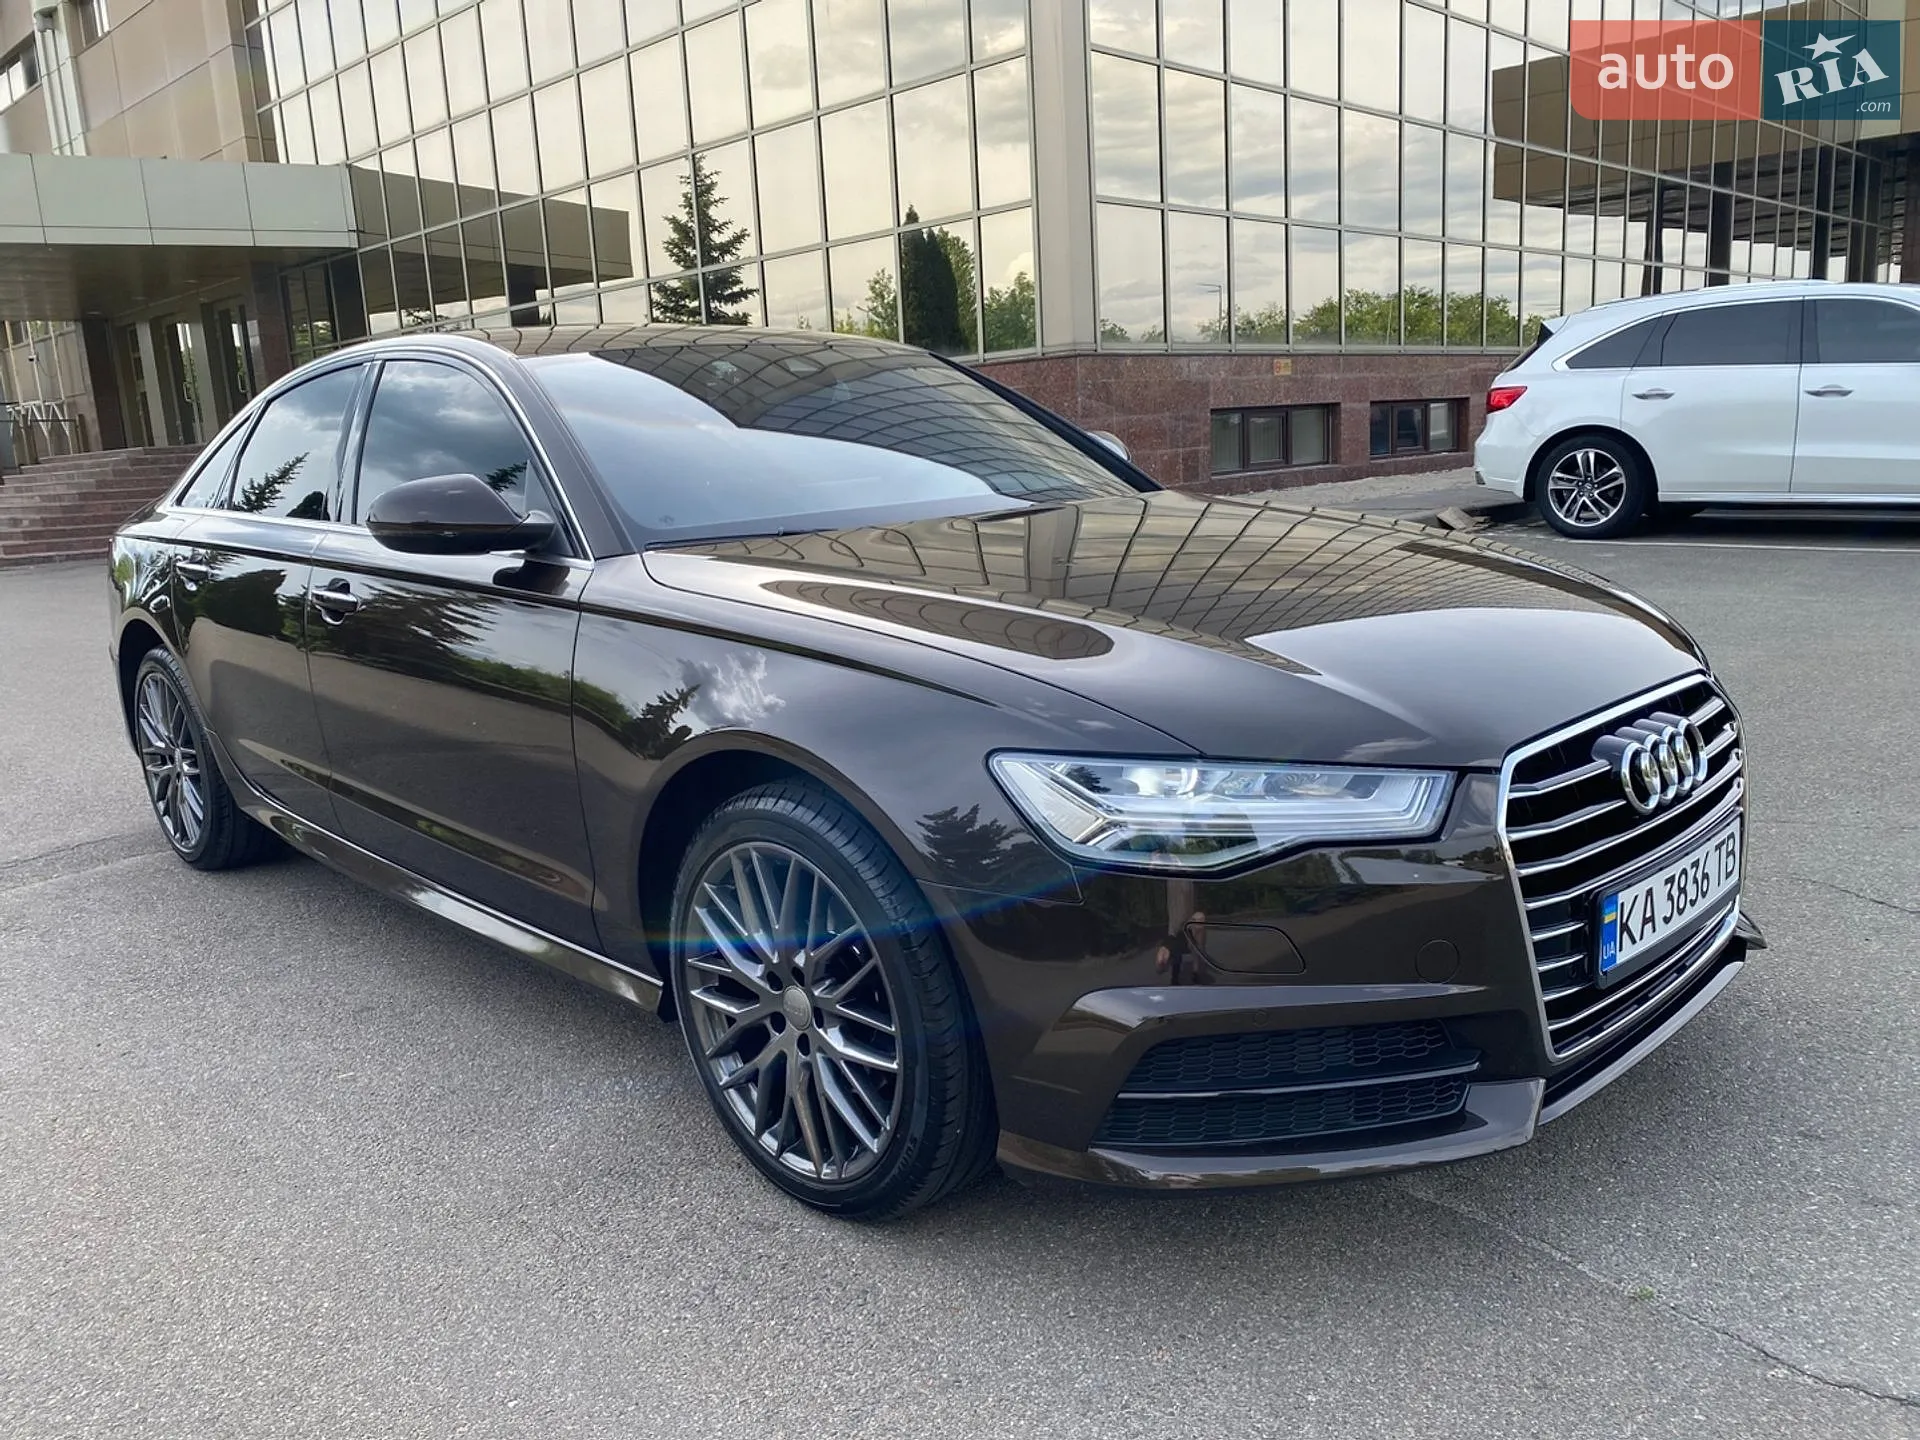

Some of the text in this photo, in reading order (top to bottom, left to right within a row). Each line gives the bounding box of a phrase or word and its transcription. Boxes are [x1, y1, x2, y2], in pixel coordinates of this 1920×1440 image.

[1618, 831, 1737, 952] KA 3836 TB
[1602, 940, 1616, 960] UA
